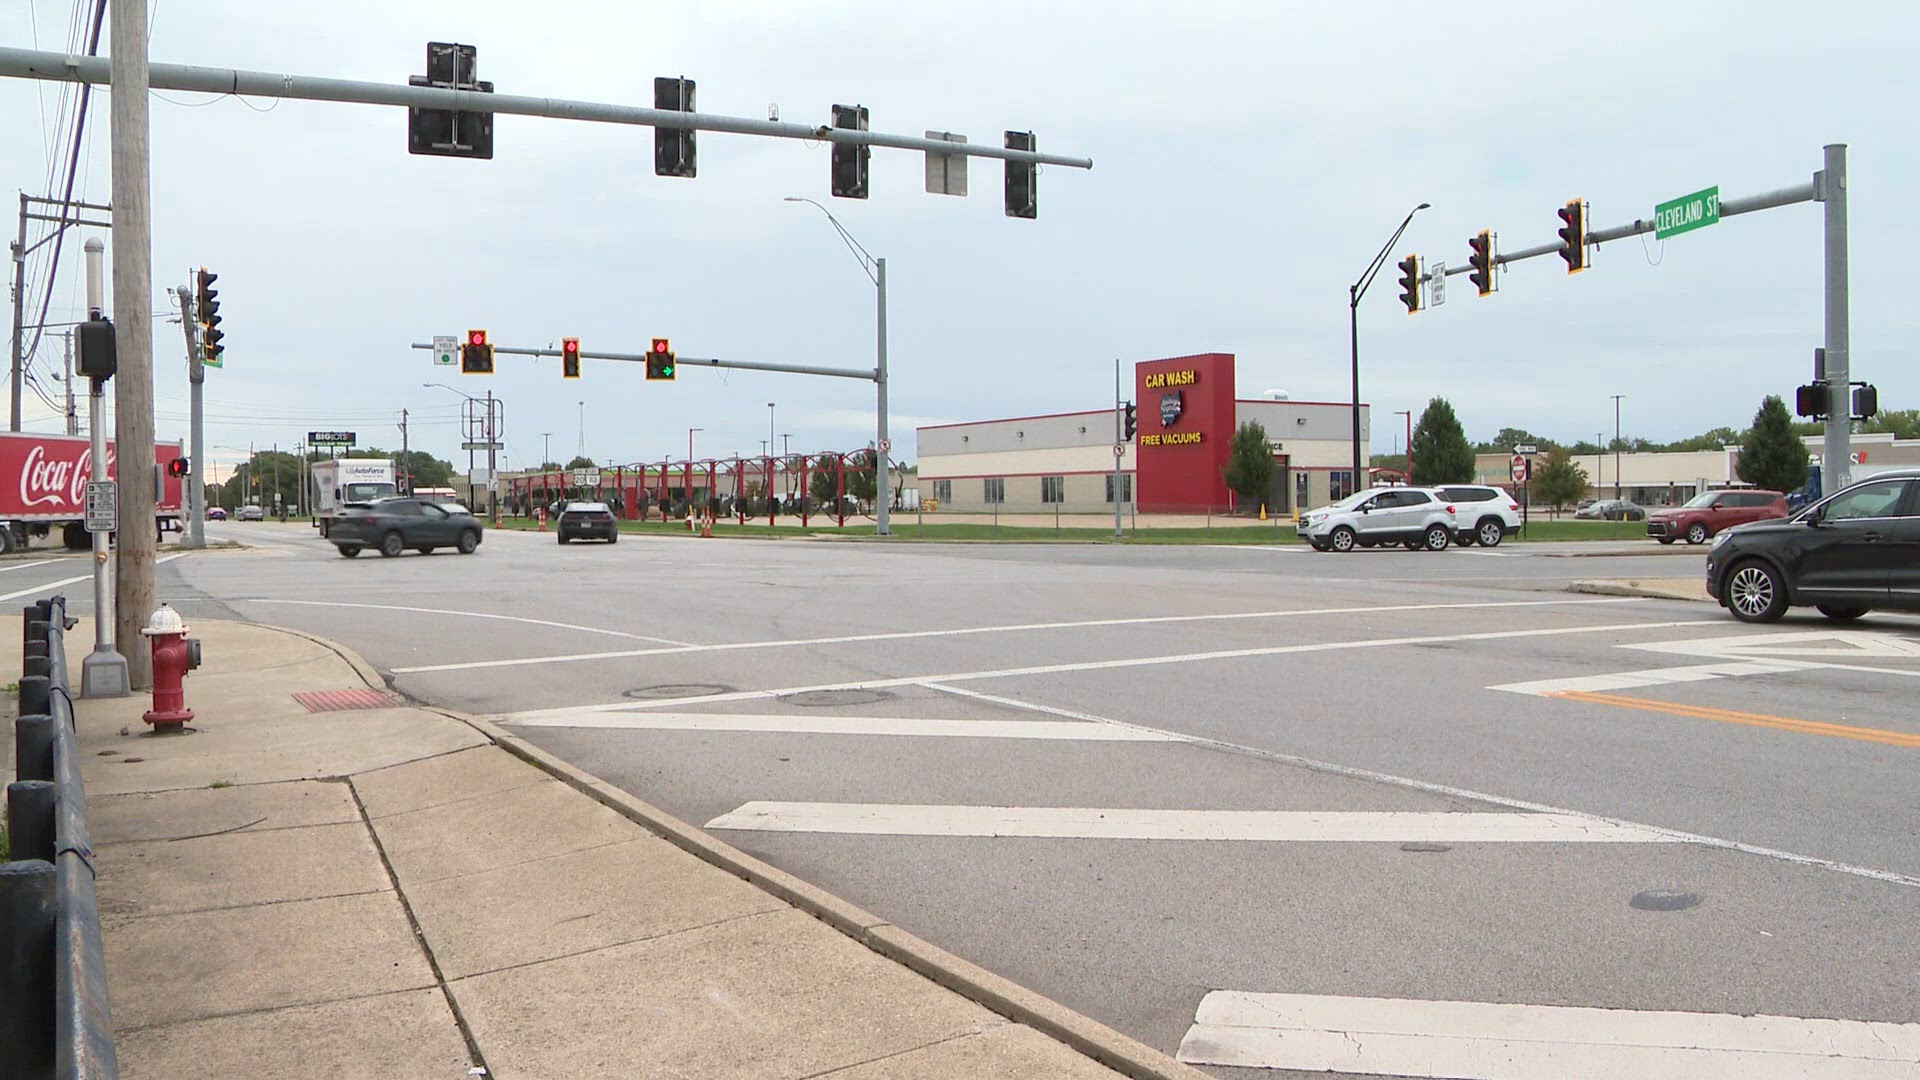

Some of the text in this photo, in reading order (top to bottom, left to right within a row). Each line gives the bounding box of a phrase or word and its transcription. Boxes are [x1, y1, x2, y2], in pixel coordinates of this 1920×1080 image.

[1656, 194, 1718, 232] CLEVELAND ST
[1145, 370, 1195, 388] CAR WASH
[1140, 432, 1201, 446] FREE VACUUMS
